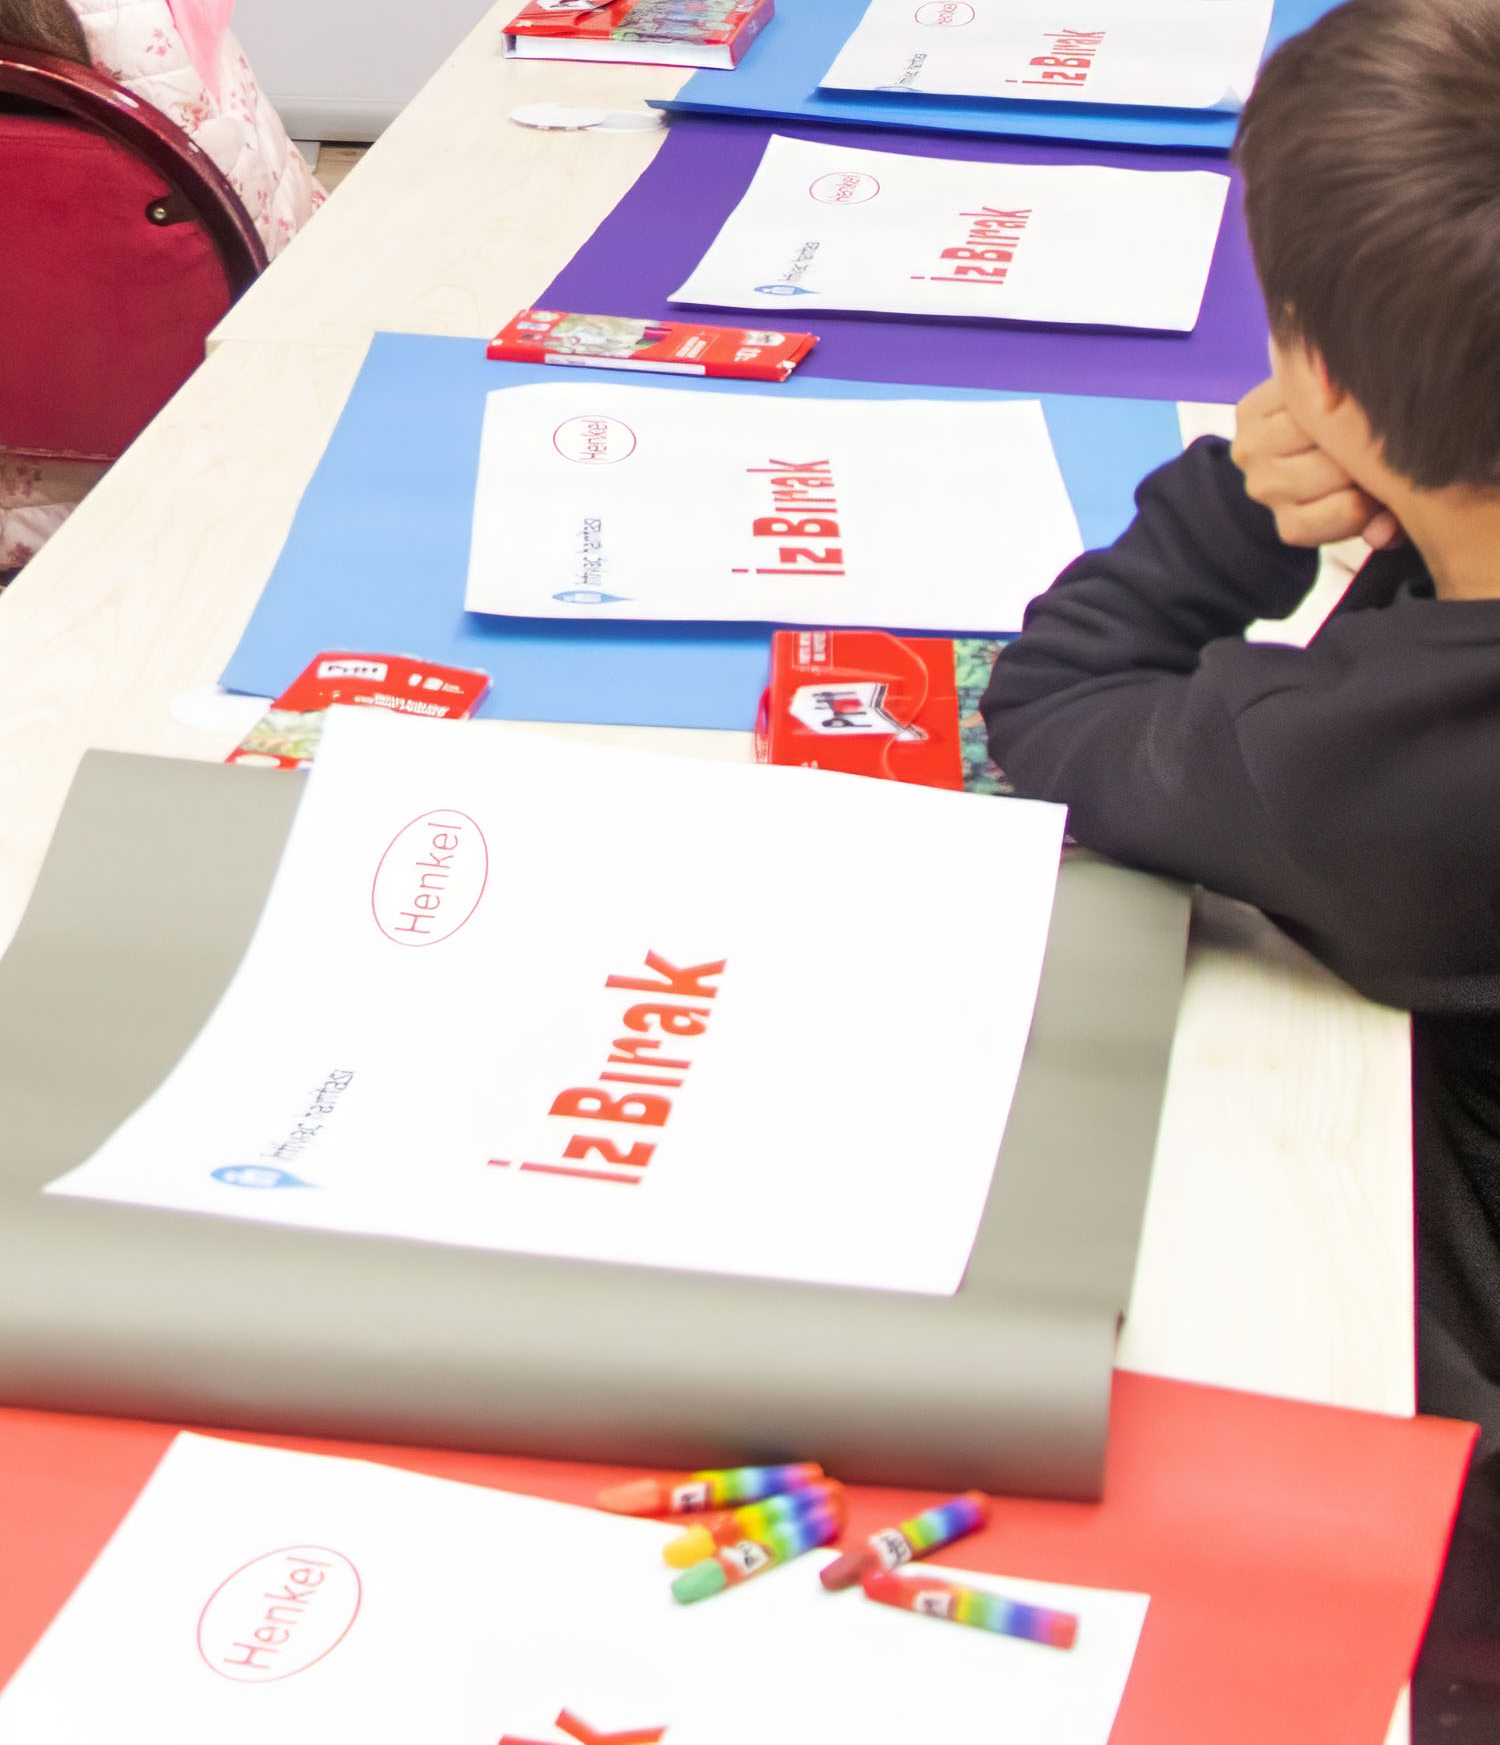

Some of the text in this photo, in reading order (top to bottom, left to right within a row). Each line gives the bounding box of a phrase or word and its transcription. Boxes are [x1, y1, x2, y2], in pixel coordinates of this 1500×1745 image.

[912, 208, 1030, 285] İz Bırak
[733, 460, 845, 576] İz Bırak
[395, 822, 462, 935] Henkel
[488, 951, 726, 1185] İz Bırak
[223, 1556, 332, 1669] Henkel
